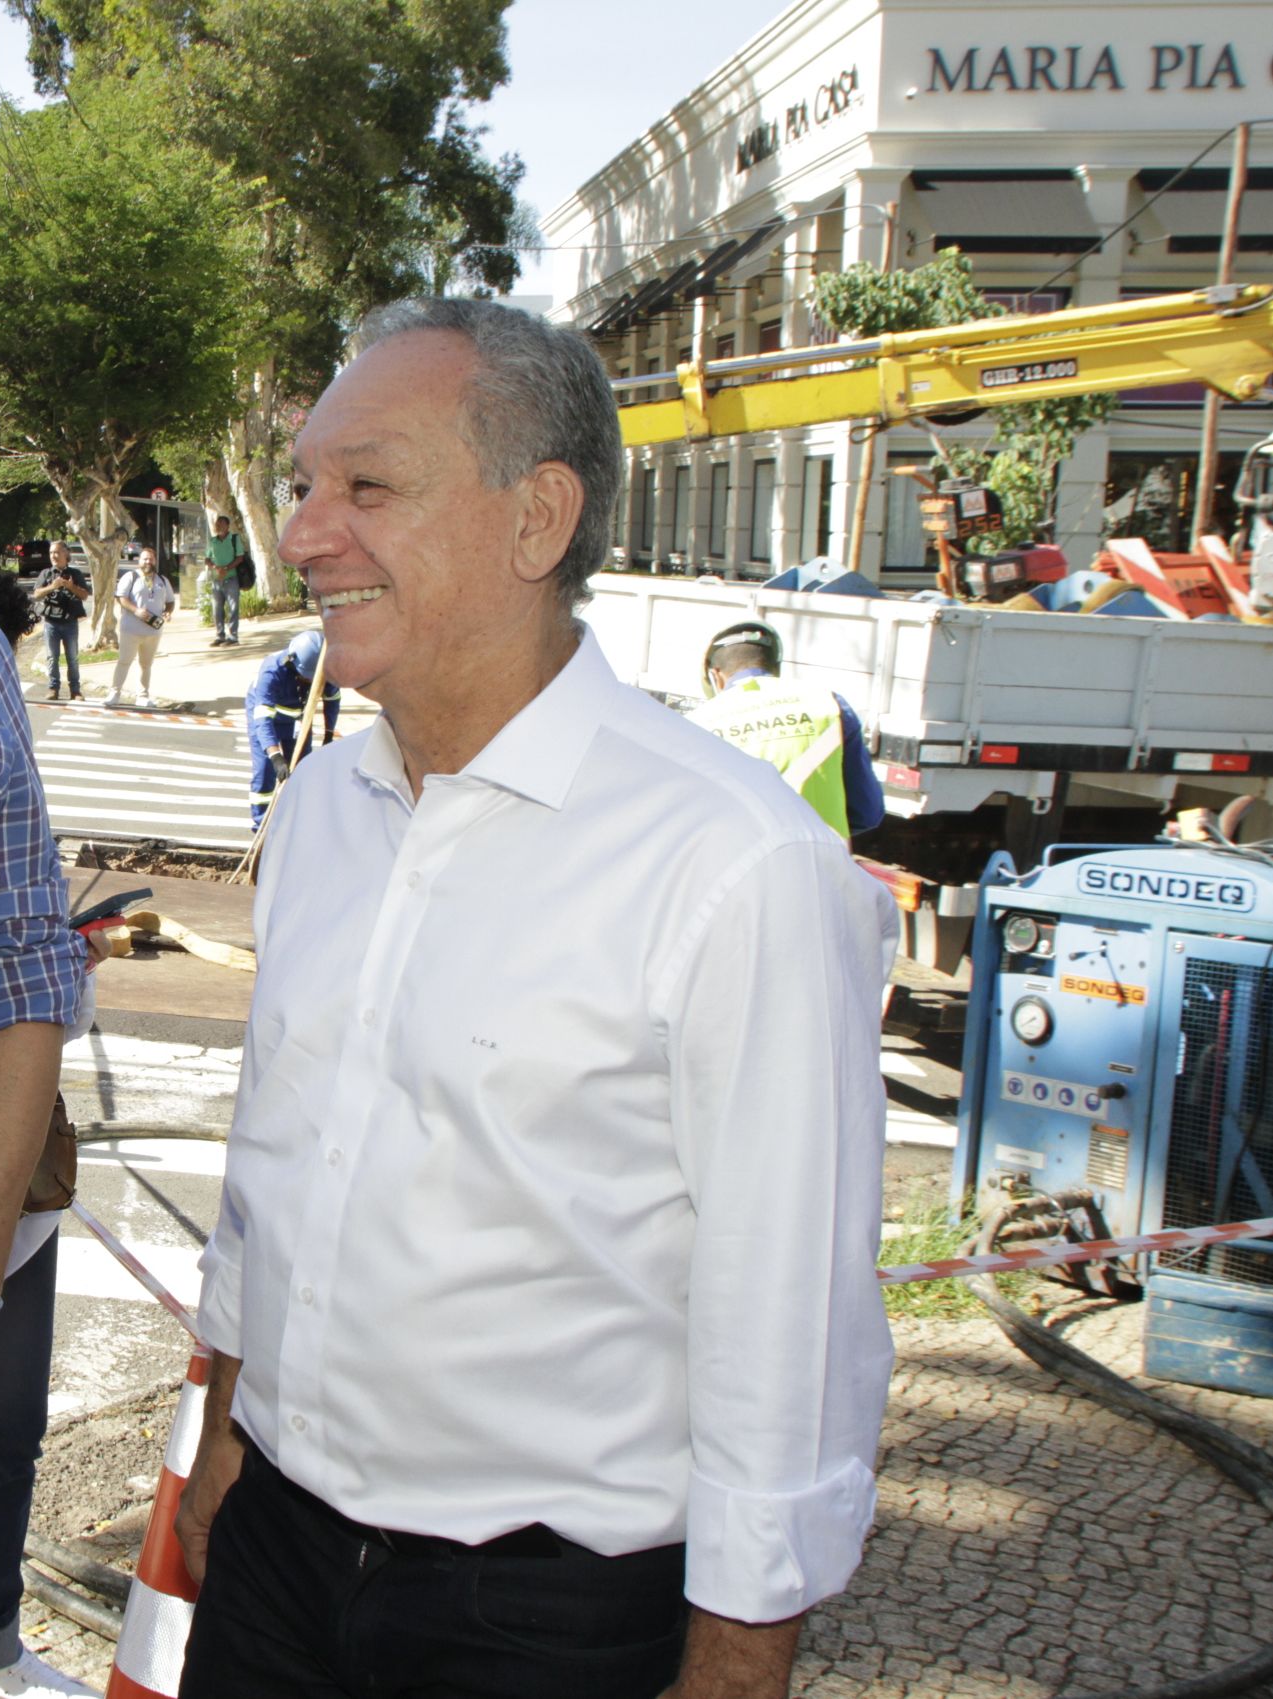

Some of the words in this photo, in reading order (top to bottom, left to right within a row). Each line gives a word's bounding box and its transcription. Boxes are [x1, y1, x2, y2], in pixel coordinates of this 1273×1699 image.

[925, 45, 1125, 93] MARIA
[1148, 43, 1246, 91] PIA
[785, 98, 809, 144] PIA
[729, 712, 813, 737] SANASA
[1085, 868, 1245, 905] SONDEQ
